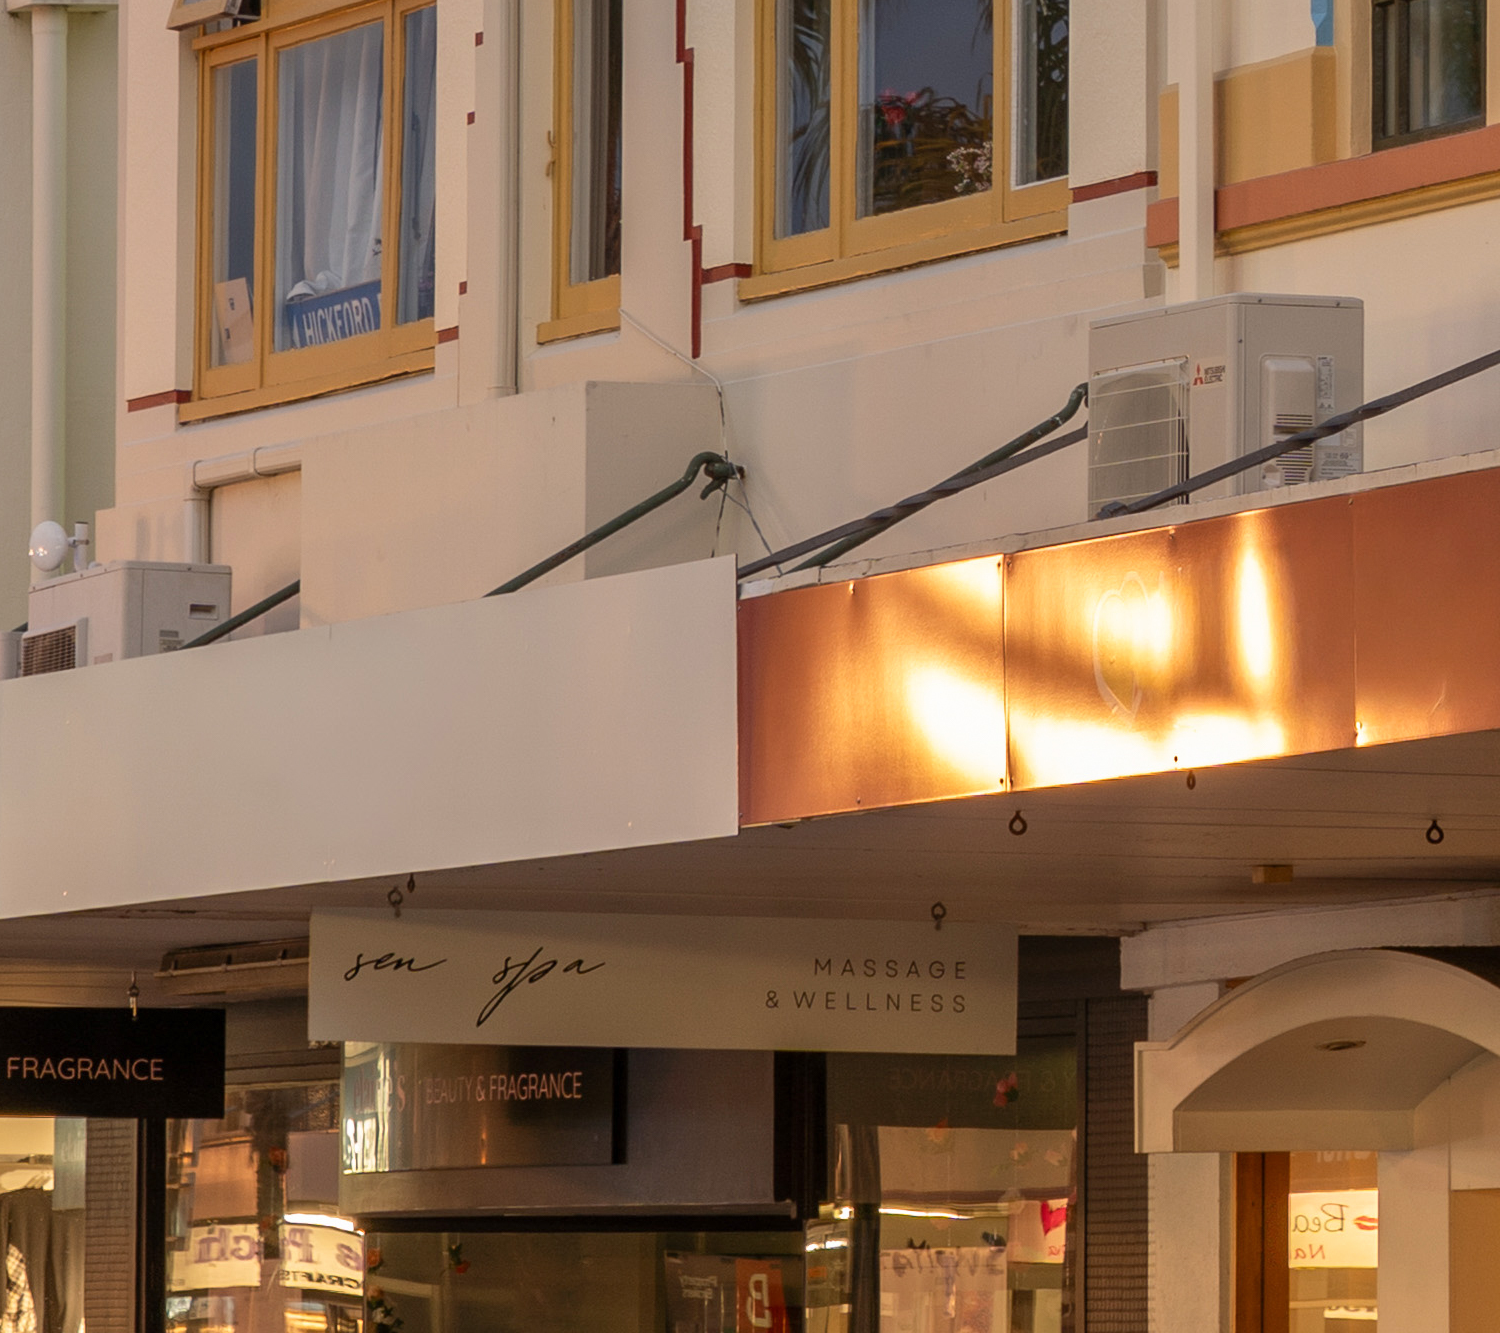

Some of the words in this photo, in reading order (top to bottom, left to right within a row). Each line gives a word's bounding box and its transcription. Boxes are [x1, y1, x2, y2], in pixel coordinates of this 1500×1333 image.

[303, 297, 374, 346] HICKFORD
[814, 957, 969, 981] MASSAGE
[344, 949, 446, 983] sen
[477, 947, 607, 1027] spa
[765, 990, 780, 1010] &
[794, 990, 968, 1014] WELLNESS
[7, 1057, 164, 1082] FRAGRANCE
[427, 1074, 474, 1104] BEAUTY
[476, 1075, 486, 1102] &
[489, 1072, 583, 1100] FRAGRANCE
